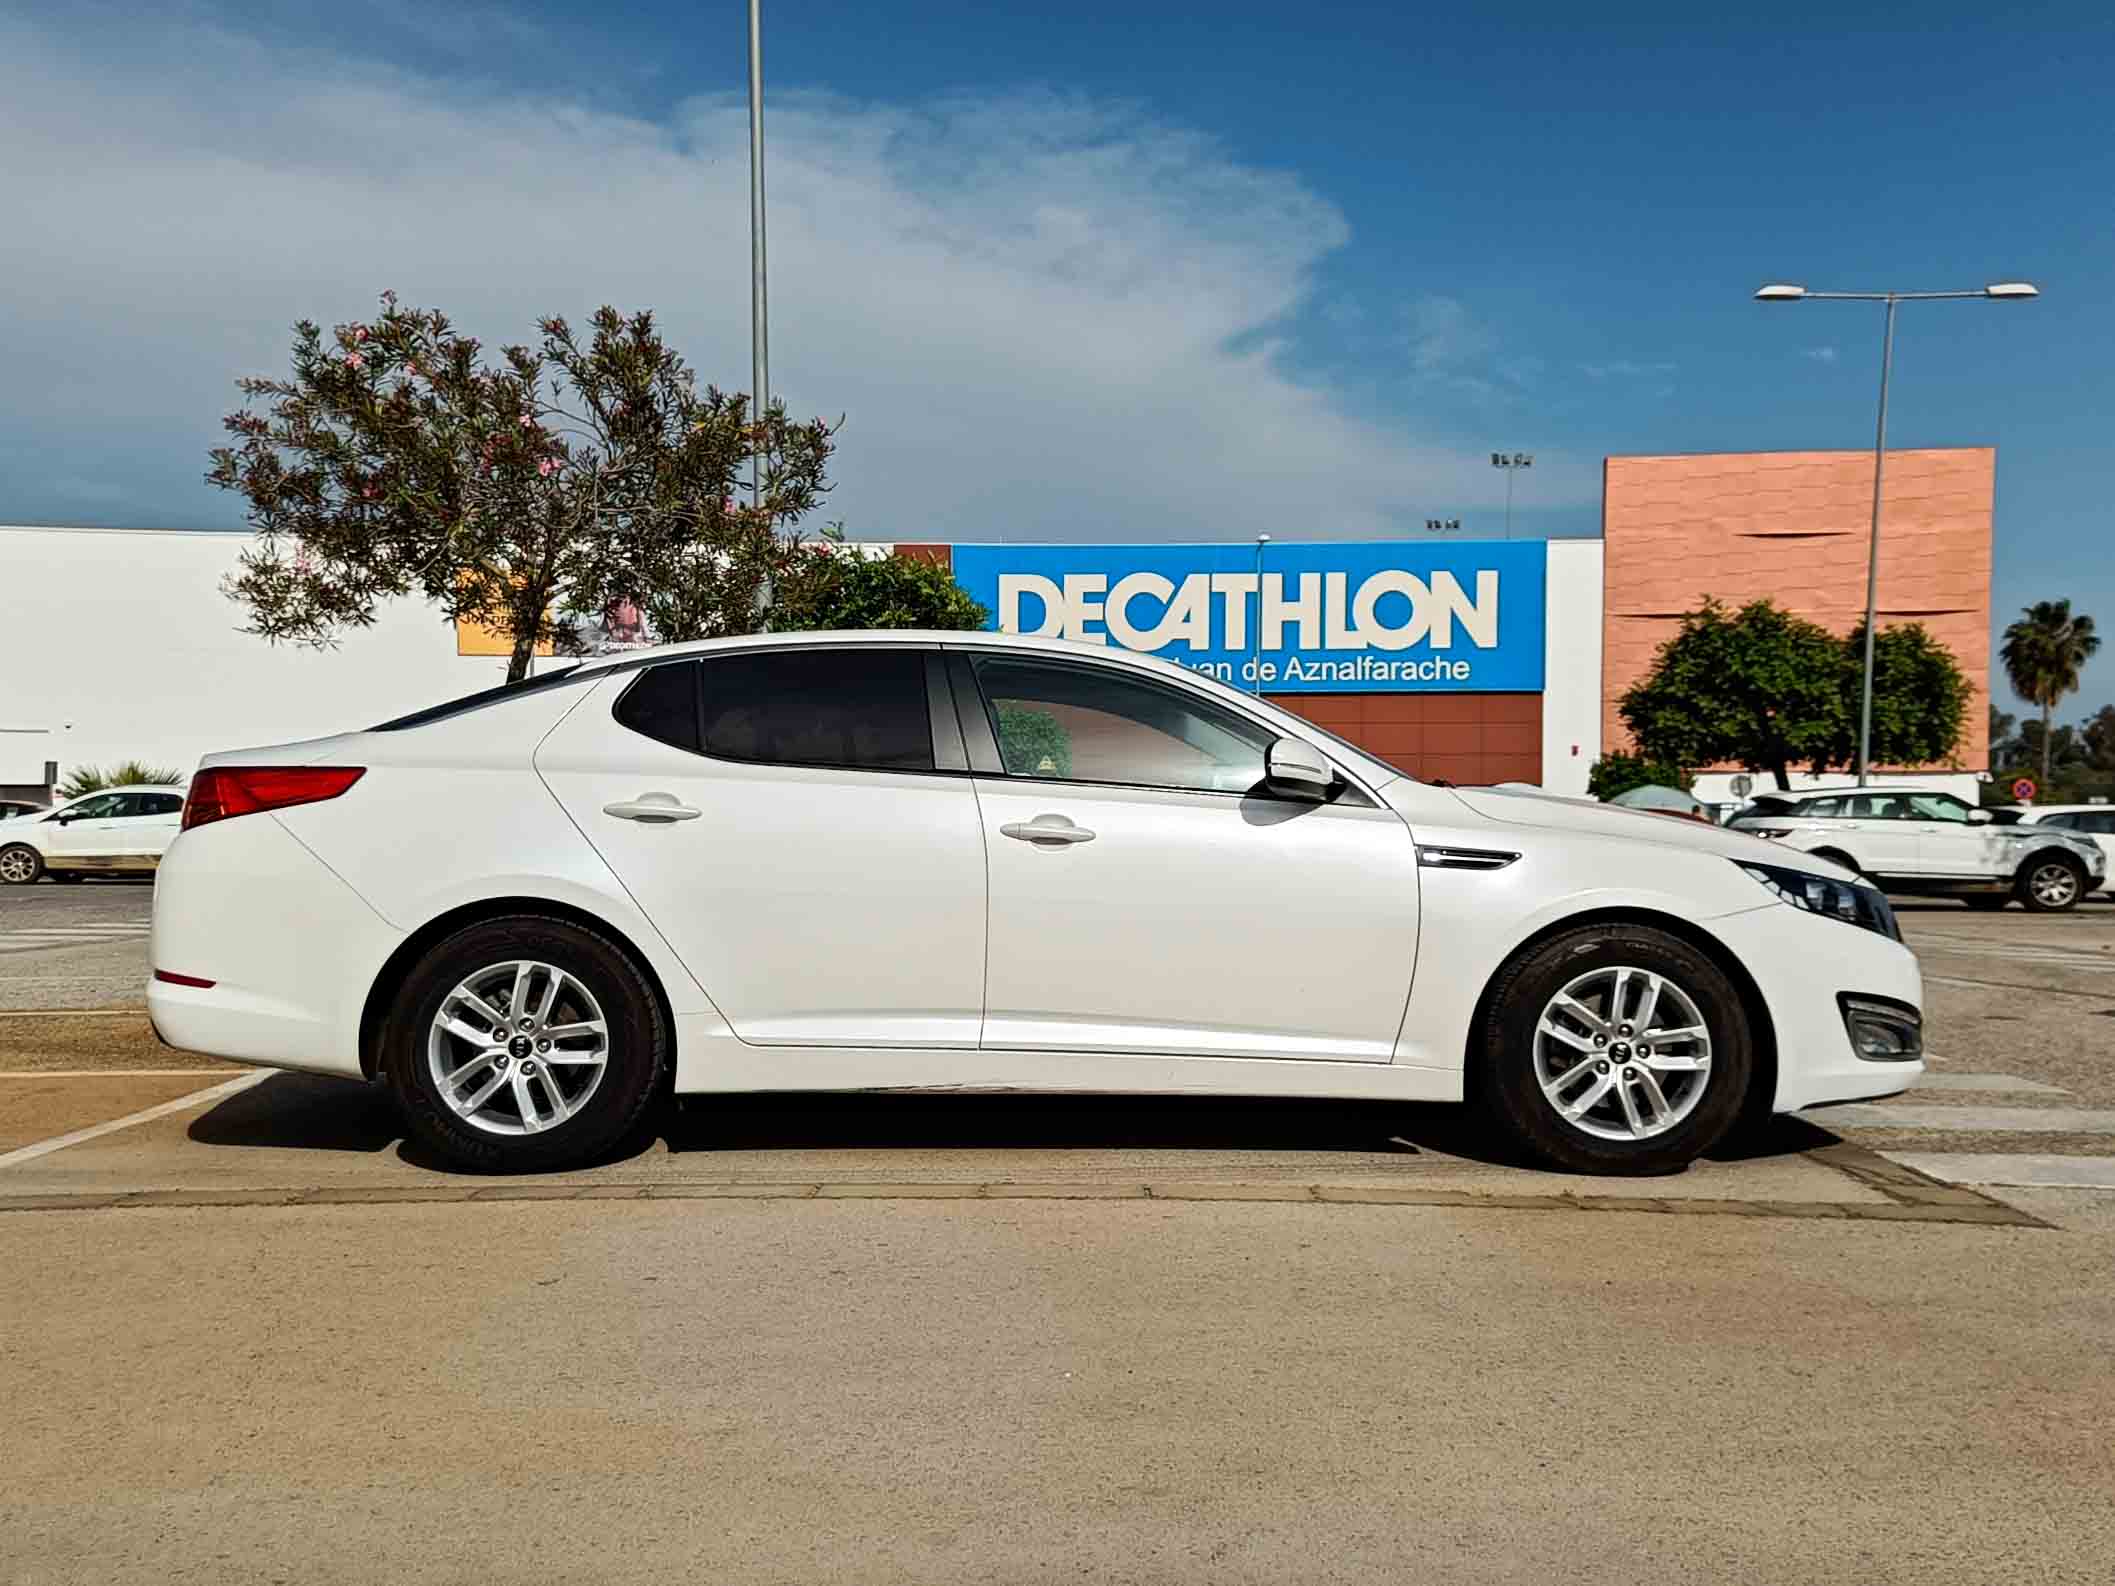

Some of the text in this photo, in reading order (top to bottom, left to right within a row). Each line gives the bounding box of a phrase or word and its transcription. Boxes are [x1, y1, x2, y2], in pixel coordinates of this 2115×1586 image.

[998, 569, 1499, 652] DECATHLON
[1241, 656, 1278, 681] de
[1283, 655, 1471, 681] Aznalfarache
